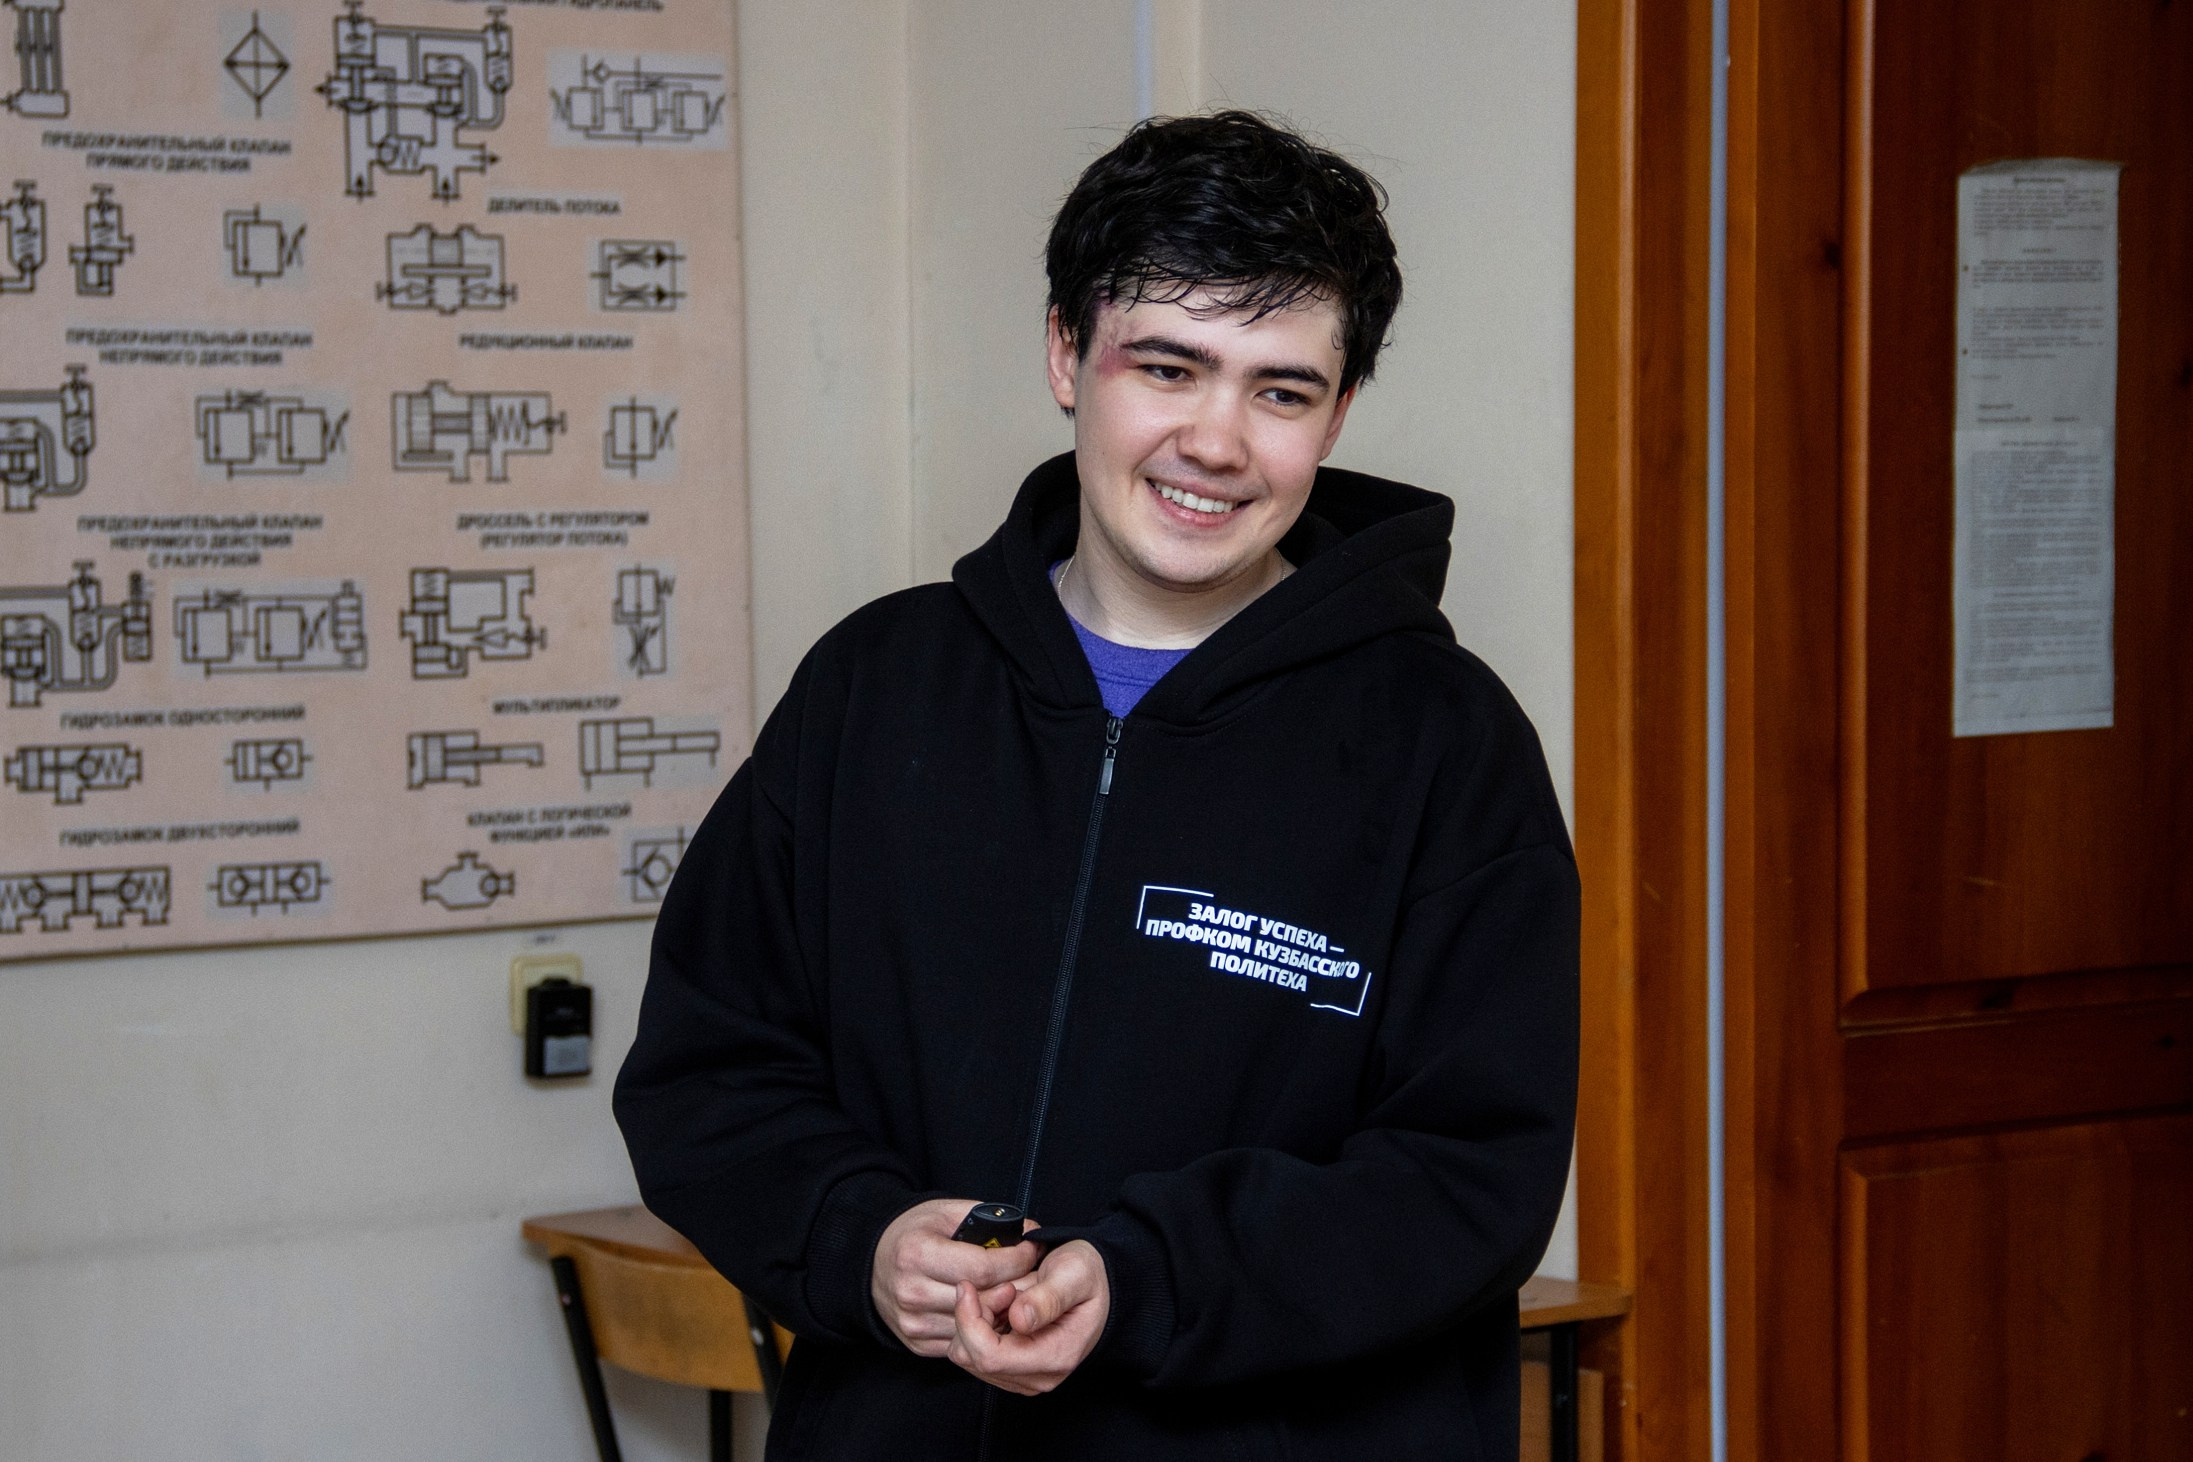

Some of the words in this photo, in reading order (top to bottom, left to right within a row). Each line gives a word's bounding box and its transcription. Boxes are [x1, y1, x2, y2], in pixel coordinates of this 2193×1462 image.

[230, 137, 292, 155] КЛАПАН
[86, 152, 164, 170] ПРЯМОГО
[166, 155, 251, 172] ДЕЙСТВИЯ
[487, 198, 561, 214] ДЕЛИТЕЛЬ
[565, 199, 621, 214] ПОТОКА
[252, 331, 313, 347] КЛАПАН
[578, 335, 634, 349] КЛАПАН
[99, 349, 196, 366] НЕПРЯМОГО
[199, 349, 282, 366] ДЕЙСТВИЯ
[262, 514, 323, 530] КЛАПАН
[456, 513, 533, 531] ДРОССЕЛЬ
[536, 511, 545, 528] С
[109, 533, 207, 550] НЕПРЯМОГО
[209, 533, 293, 549] ДЕЙСТВИЯ
[147, 552, 158, 569] С
[466, 808, 524, 827] КЛАПАН
[527, 808, 537, 824] С
[1145, 918, 1251, 954] ПРОФКОМ
[1188, 902, 1258, 932] ЗАЛОГ
[1259, 917, 1328, 953] УСПЕХА
[1209, 951, 1309, 992] ПОЛИТЕХА
